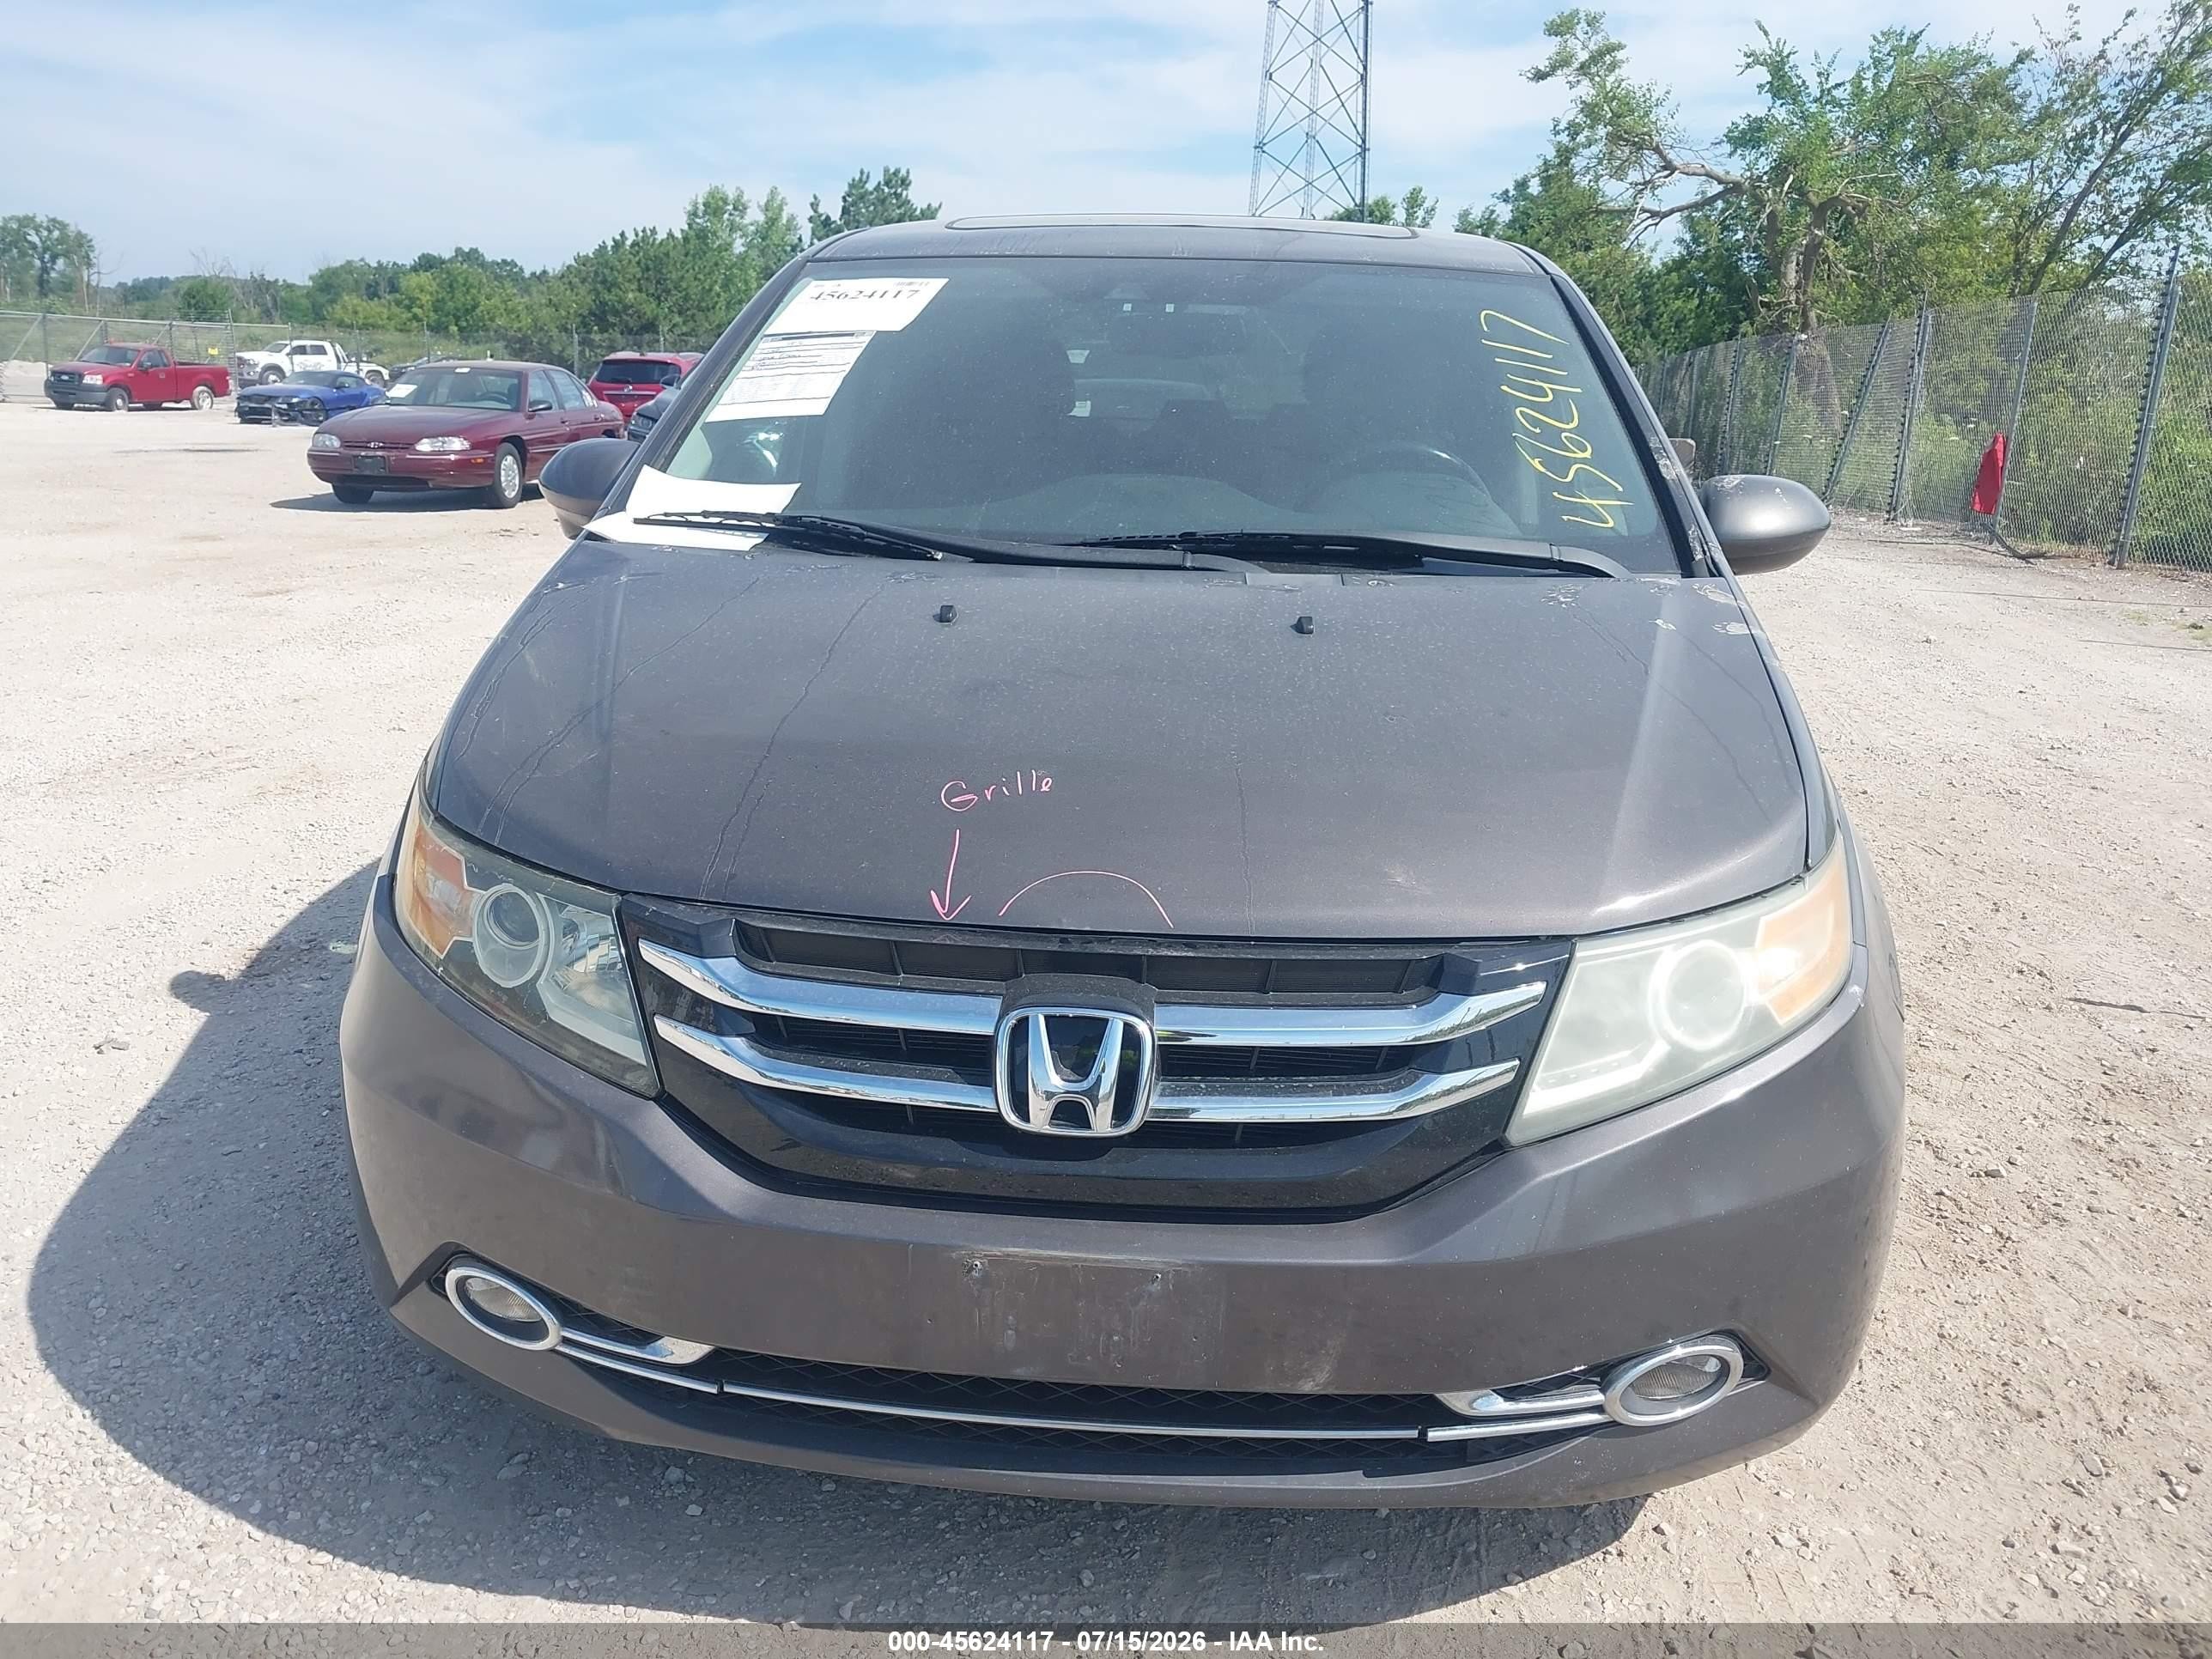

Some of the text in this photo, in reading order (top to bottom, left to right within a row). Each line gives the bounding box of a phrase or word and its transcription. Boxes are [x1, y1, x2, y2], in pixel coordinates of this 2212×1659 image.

[811, 289, 921, 301] 45624117
[1480, 309, 1635, 528] 45624117
[940, 769, 1053, 811] Grille
